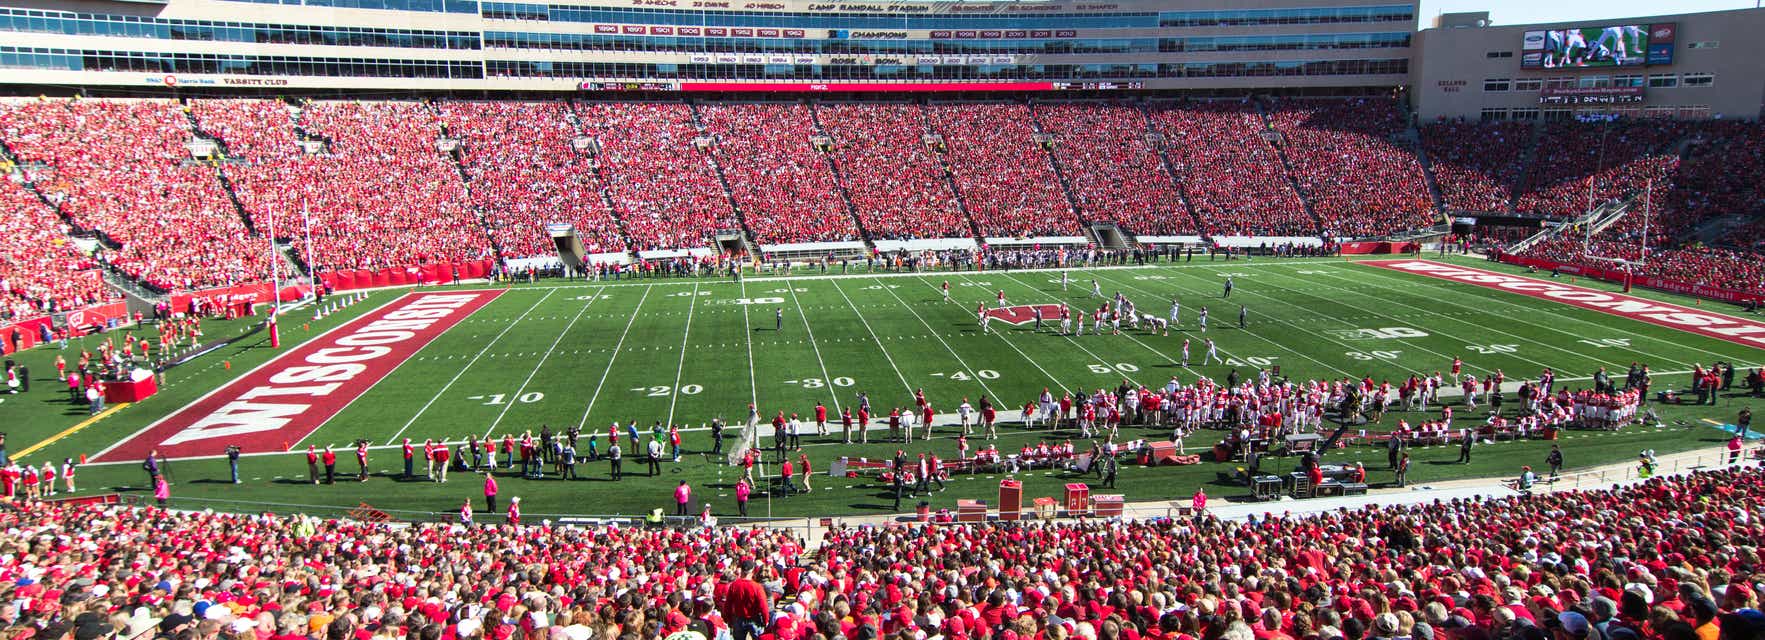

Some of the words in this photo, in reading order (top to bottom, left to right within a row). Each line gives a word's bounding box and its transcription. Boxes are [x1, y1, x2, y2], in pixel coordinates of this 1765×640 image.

[160, 293, 482, 446] WISCONSIN
[1088, 363, 1140, 374] 50
[949, 369, 1001, 381] 40
[806, 376, 856, 388] 30
[647, 384, 704, 397] 20
[484, 391, 545, 405] 10
